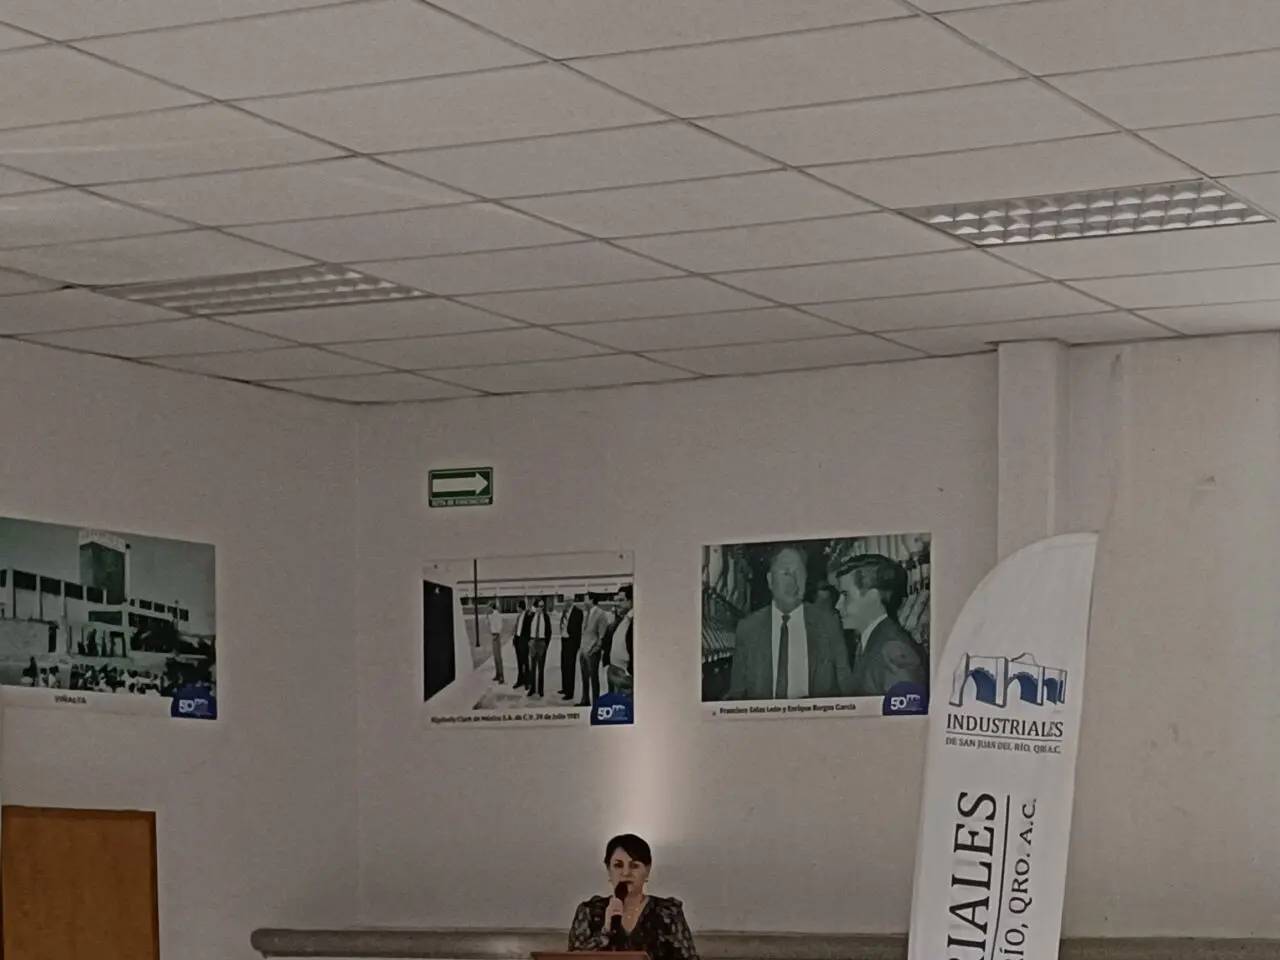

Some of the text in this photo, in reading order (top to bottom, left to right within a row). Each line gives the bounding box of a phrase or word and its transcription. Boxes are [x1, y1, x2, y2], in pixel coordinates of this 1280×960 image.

[890, 696, 906, 710] 50
[597, 706, 613, 720] 50
[947, 713, 1064, 738] INDUSTRIALES
[946, 737, 957, 746] DE
[958, 738, 976, 747] SAN
[977, 740, 996, 749] JUAN
[997, 742, 1013, 751] DEL
[1019, 798, 1037, 846] A.C.
[1008, 852, 1032, 914] QRO.
